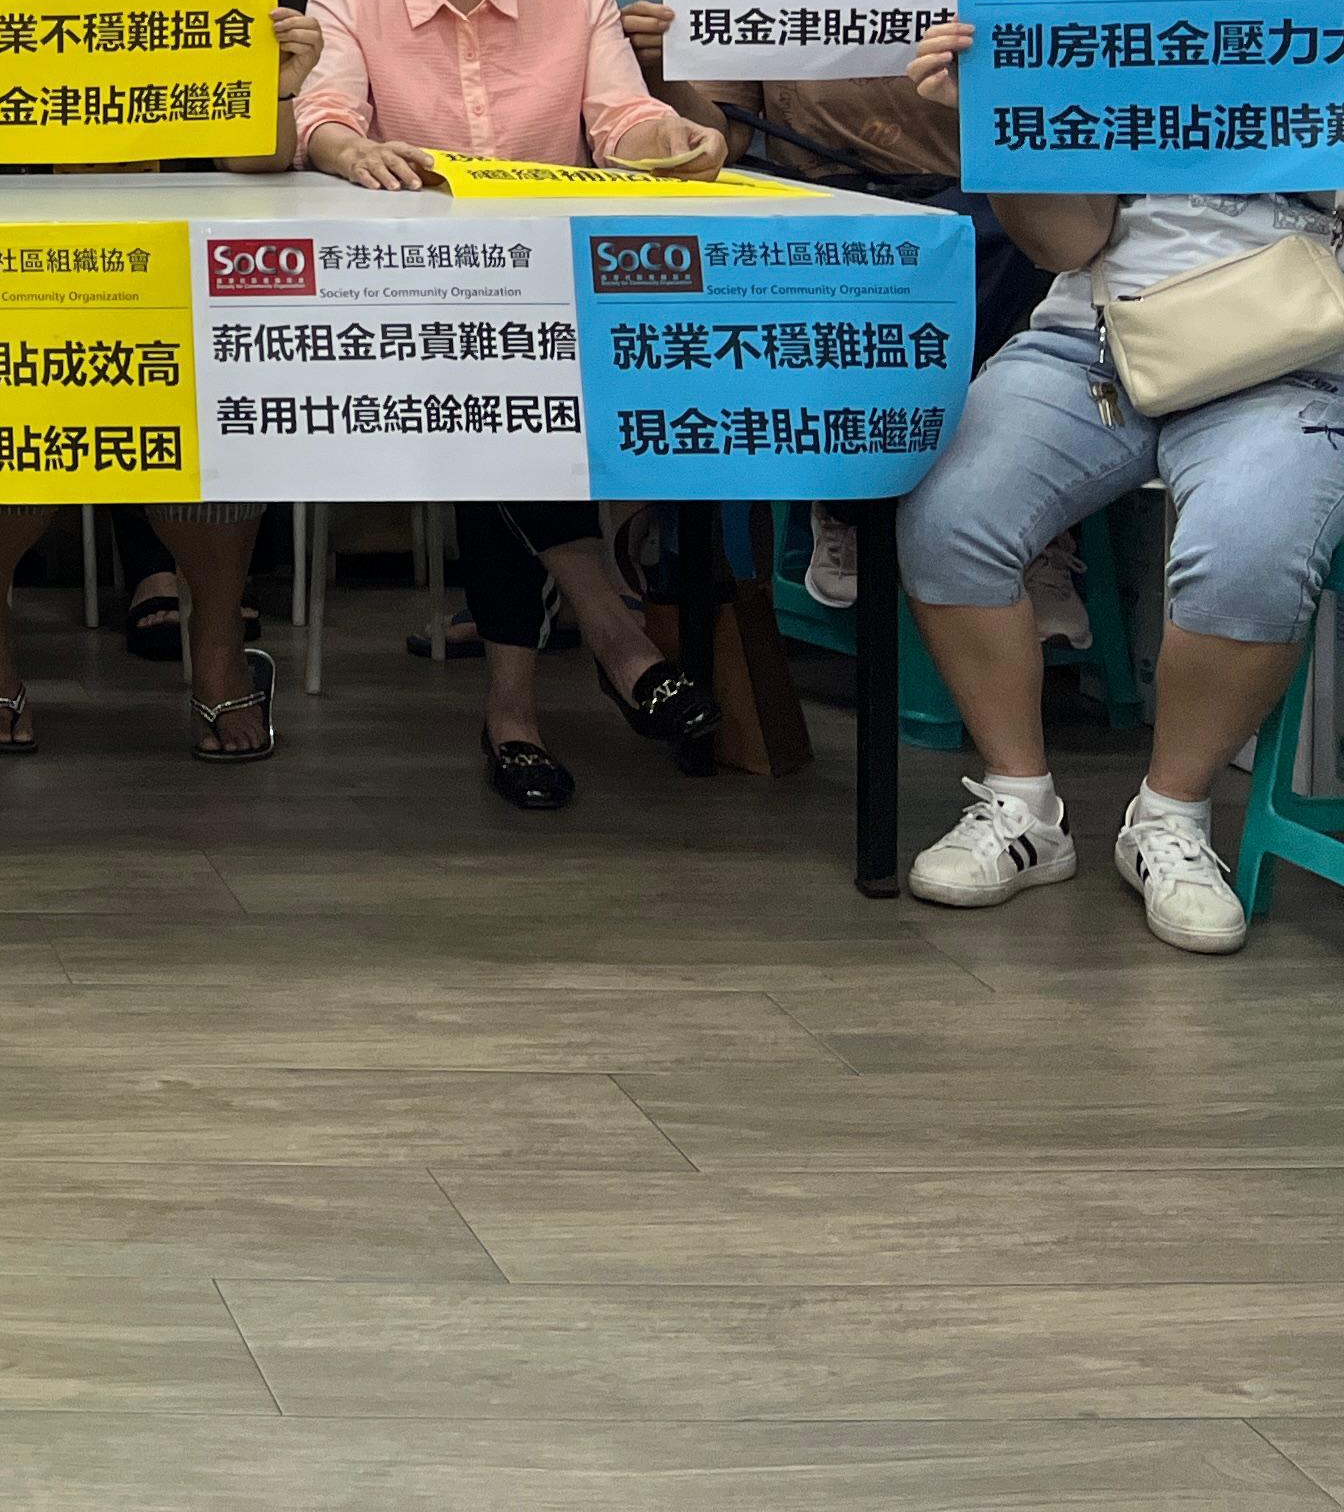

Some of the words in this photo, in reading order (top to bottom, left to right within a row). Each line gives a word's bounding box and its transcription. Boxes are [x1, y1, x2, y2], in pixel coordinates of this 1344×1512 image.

[318, 242, 533, 269] 香港社區組織協會
[705, 240, 920, 268] 香港社區組織協會
[213, 321, 577, 363] 薪低租金昂貴難負擔
[612, 322, 950, 370] 就業不穩難搵食
[217, 395, 580, 435] 善用廿億結餘解民困
[618, 406, 945, 456] 現金津貼應繼續
